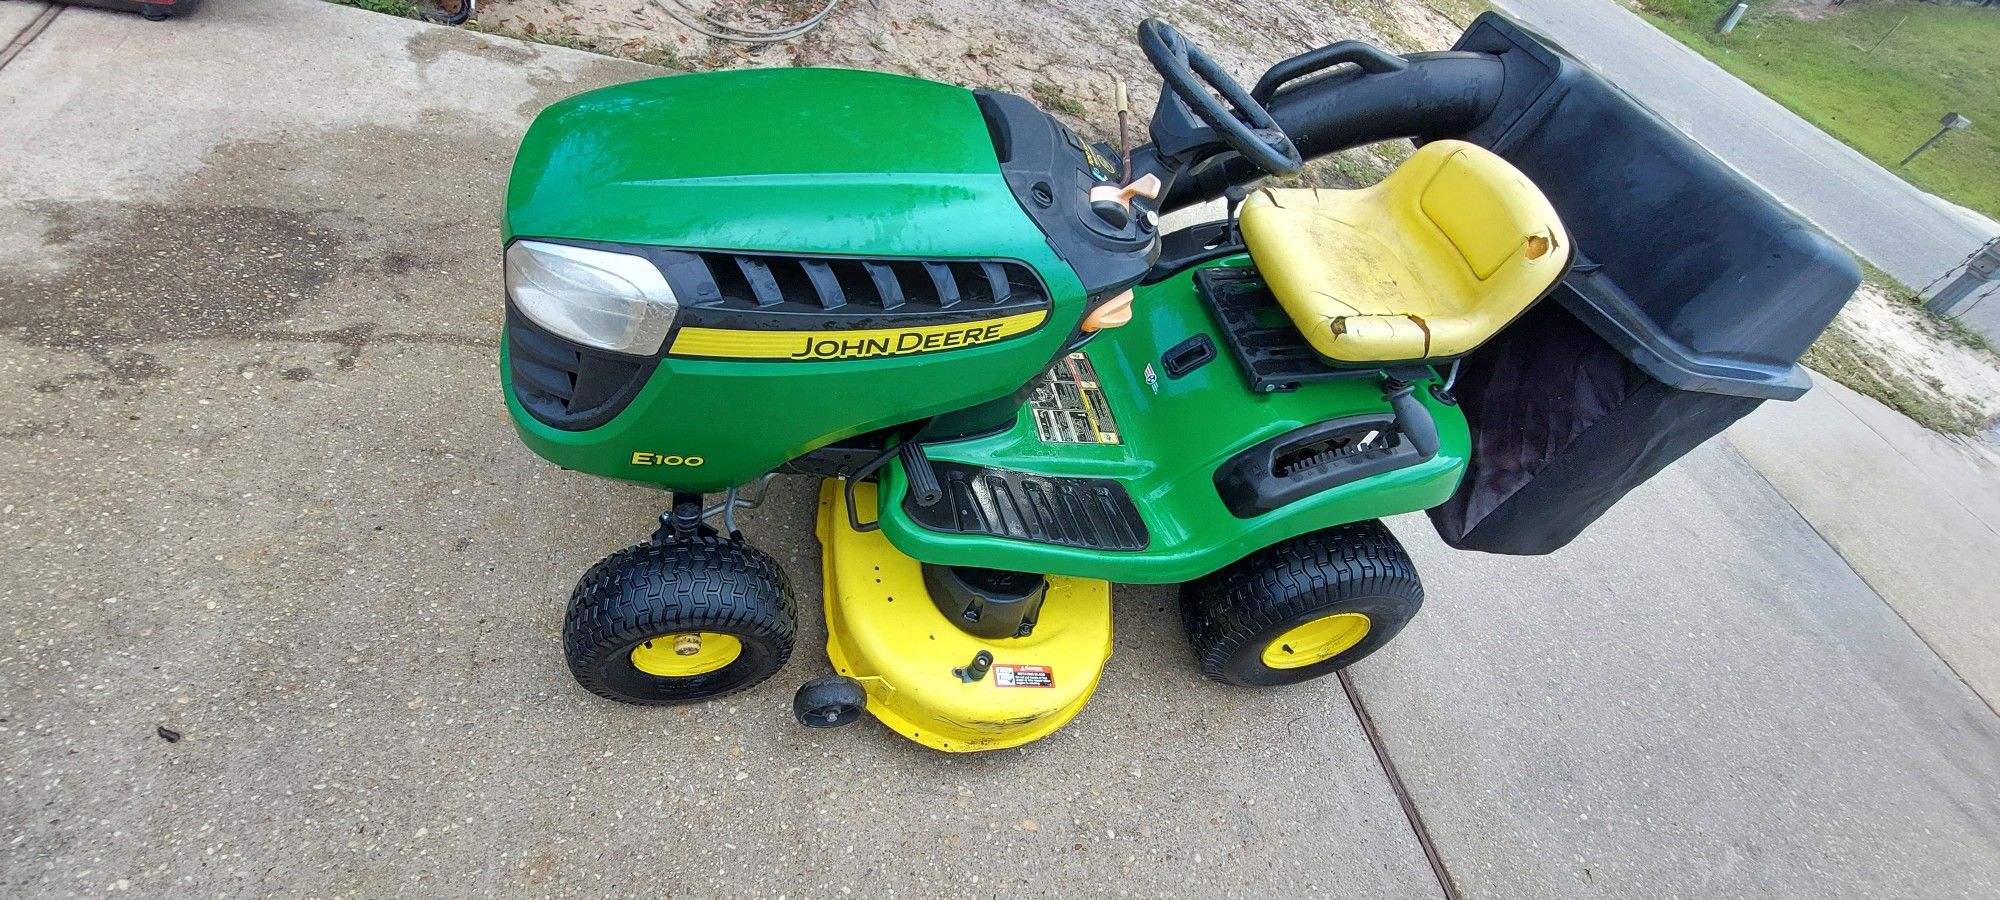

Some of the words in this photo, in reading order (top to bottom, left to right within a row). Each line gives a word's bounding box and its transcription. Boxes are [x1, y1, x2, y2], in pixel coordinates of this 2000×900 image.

[791, 337, 890, 357] JOHN
[896, 323, 1004, 352] DEERE
[631, 451, 704, 467] E100
